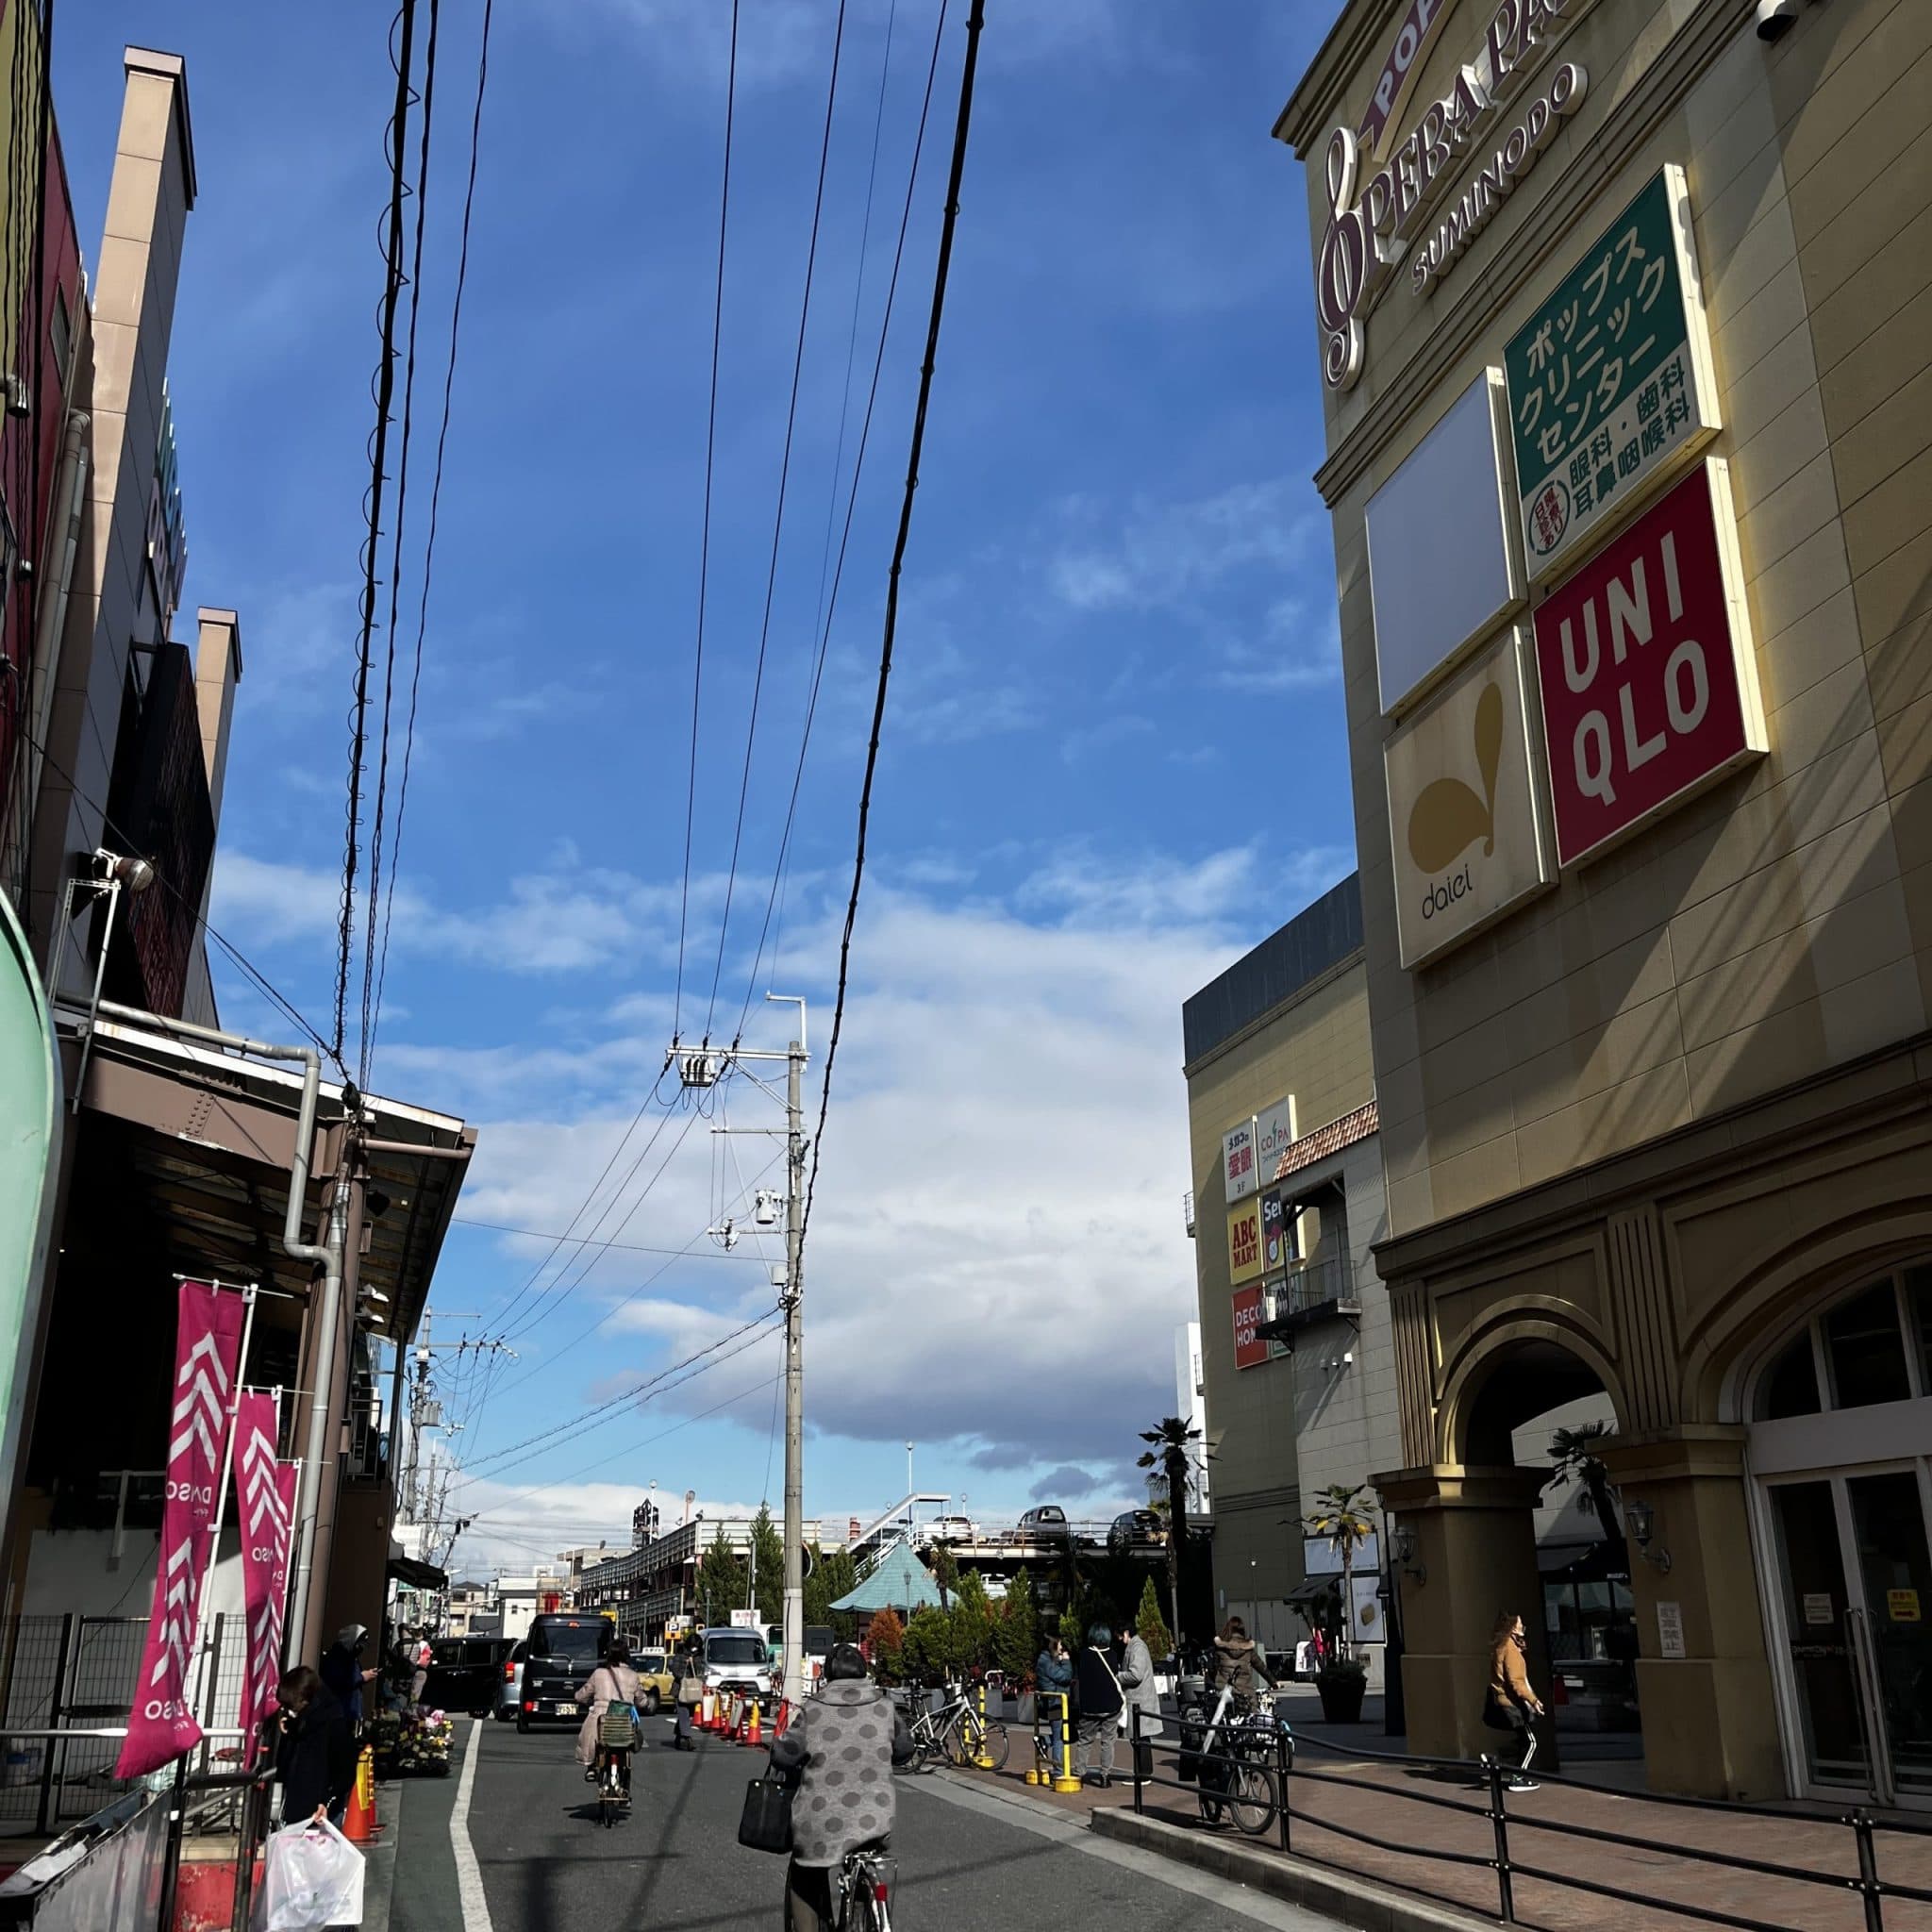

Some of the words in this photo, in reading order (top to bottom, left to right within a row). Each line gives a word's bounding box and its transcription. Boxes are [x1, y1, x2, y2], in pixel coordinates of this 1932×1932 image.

[1318, 64, 1487, 389] OPERA
[1412, 63, 1580, 295] SUMINODO
[1519, 255, 1665, 437] クリニック
[1526, 225, 1646, 377] ポップス
[1537, 333, 1657, 465] センター
[1574, 389, 1691, 521] 耳鼻咽喉科
[1559, 531, 1684, 694] UNI
[1573, 640, 1710, 807] QLO
[1233, 1215, 1257, 1250] ABC
[1233, 1242, 1257, 1269] MART
[1236, 1304, 1262, 1327] DECO
[1237, 1328, 1257, 1348] HOM
